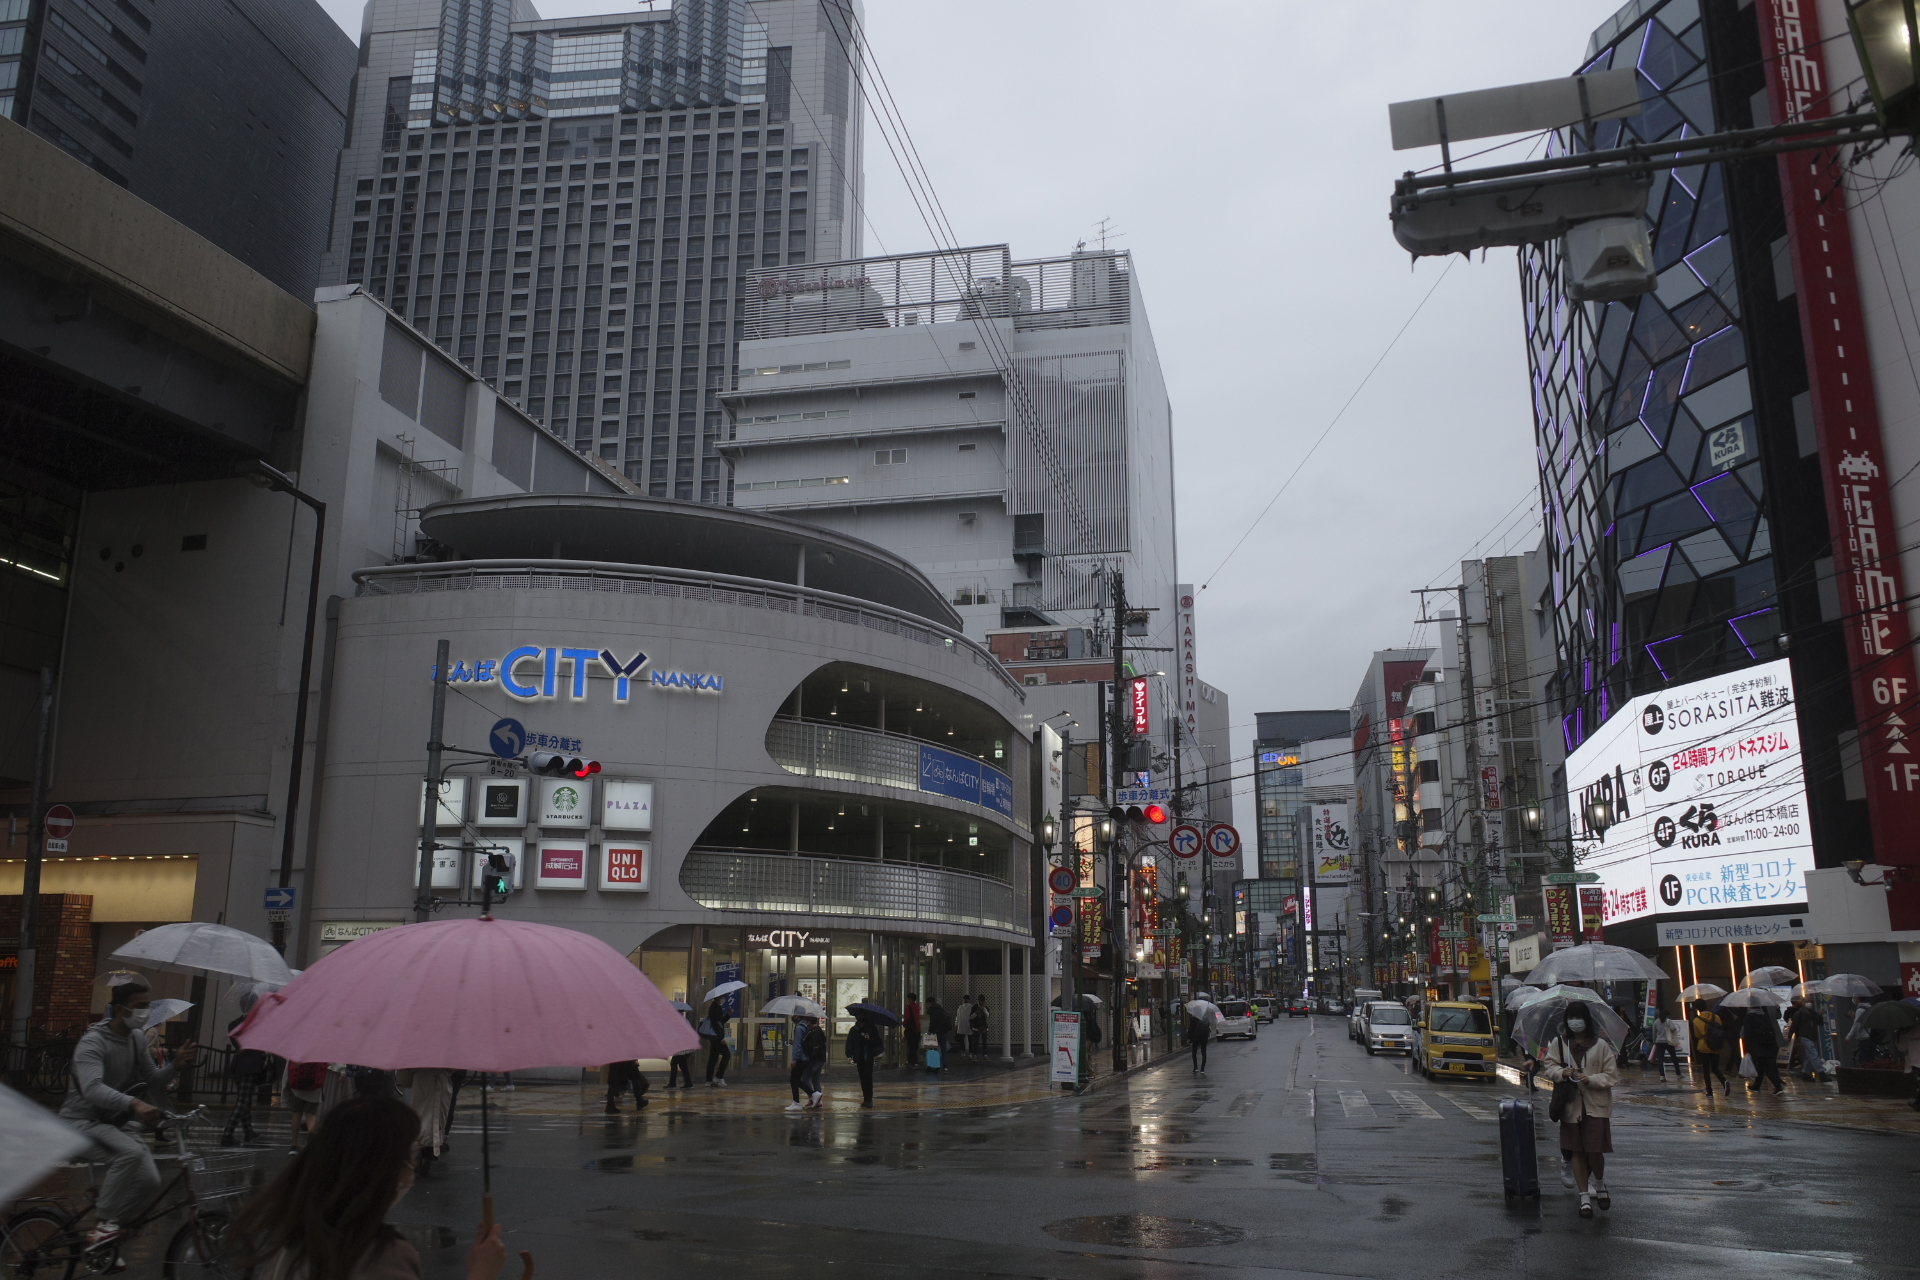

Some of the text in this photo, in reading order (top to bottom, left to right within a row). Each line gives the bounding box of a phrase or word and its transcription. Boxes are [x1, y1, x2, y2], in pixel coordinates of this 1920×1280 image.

[1712, 427, 1739, 448] くら
[1714, 443, 1740, 460] KURA
[1852, 484, 1899, 657] GAME
[1852, 556, 1874, 655] STATION
[500, 645, 648, 701] CITY
[652, 670, 723, 691] NANKAI
[1872, 677, 1908, 705] 6F
[1134, 690, 1148, 725] アイフル
[525, 732, 582, 753] 歩車分離式
[1672, 731, 1790, 771] 24時間フィットネスジム
[1651, 766, 1668, 787] 6F
[1707, 763, 1768, 788] TORQUE
[1884, 762, 1920, 791] 1F
[1117, 788, 1170, 801] 歩車分離式
[606, 800, 648, 811] PLAZA
[1722, 803, 1800, 827] なんば日本橋店
[1679, 803, 1719, 834] くら
[1657, 822, 1674, 841] 4F
[1681, 832, 1722, 850] KURA
[612, 852, 637, 865] UNI
[1212, 860, 1235, 868] ここから
[611, 866, 638, 880] QLO
[1055, 875, 1071, 887] 40
[1553, 873, 1594, 881] なんさん通り
[1719, 857, 1798, 884] 新型コロナ
[1664, 880, 1679, 900] 1F
[1559, 889, 1571, 934] インターネット
[748, 933, 769, 943] なんば
[769, 929, 810, 949] CITY
[1664, 921, 1790, 941] 新型コロナPCR検査センター
